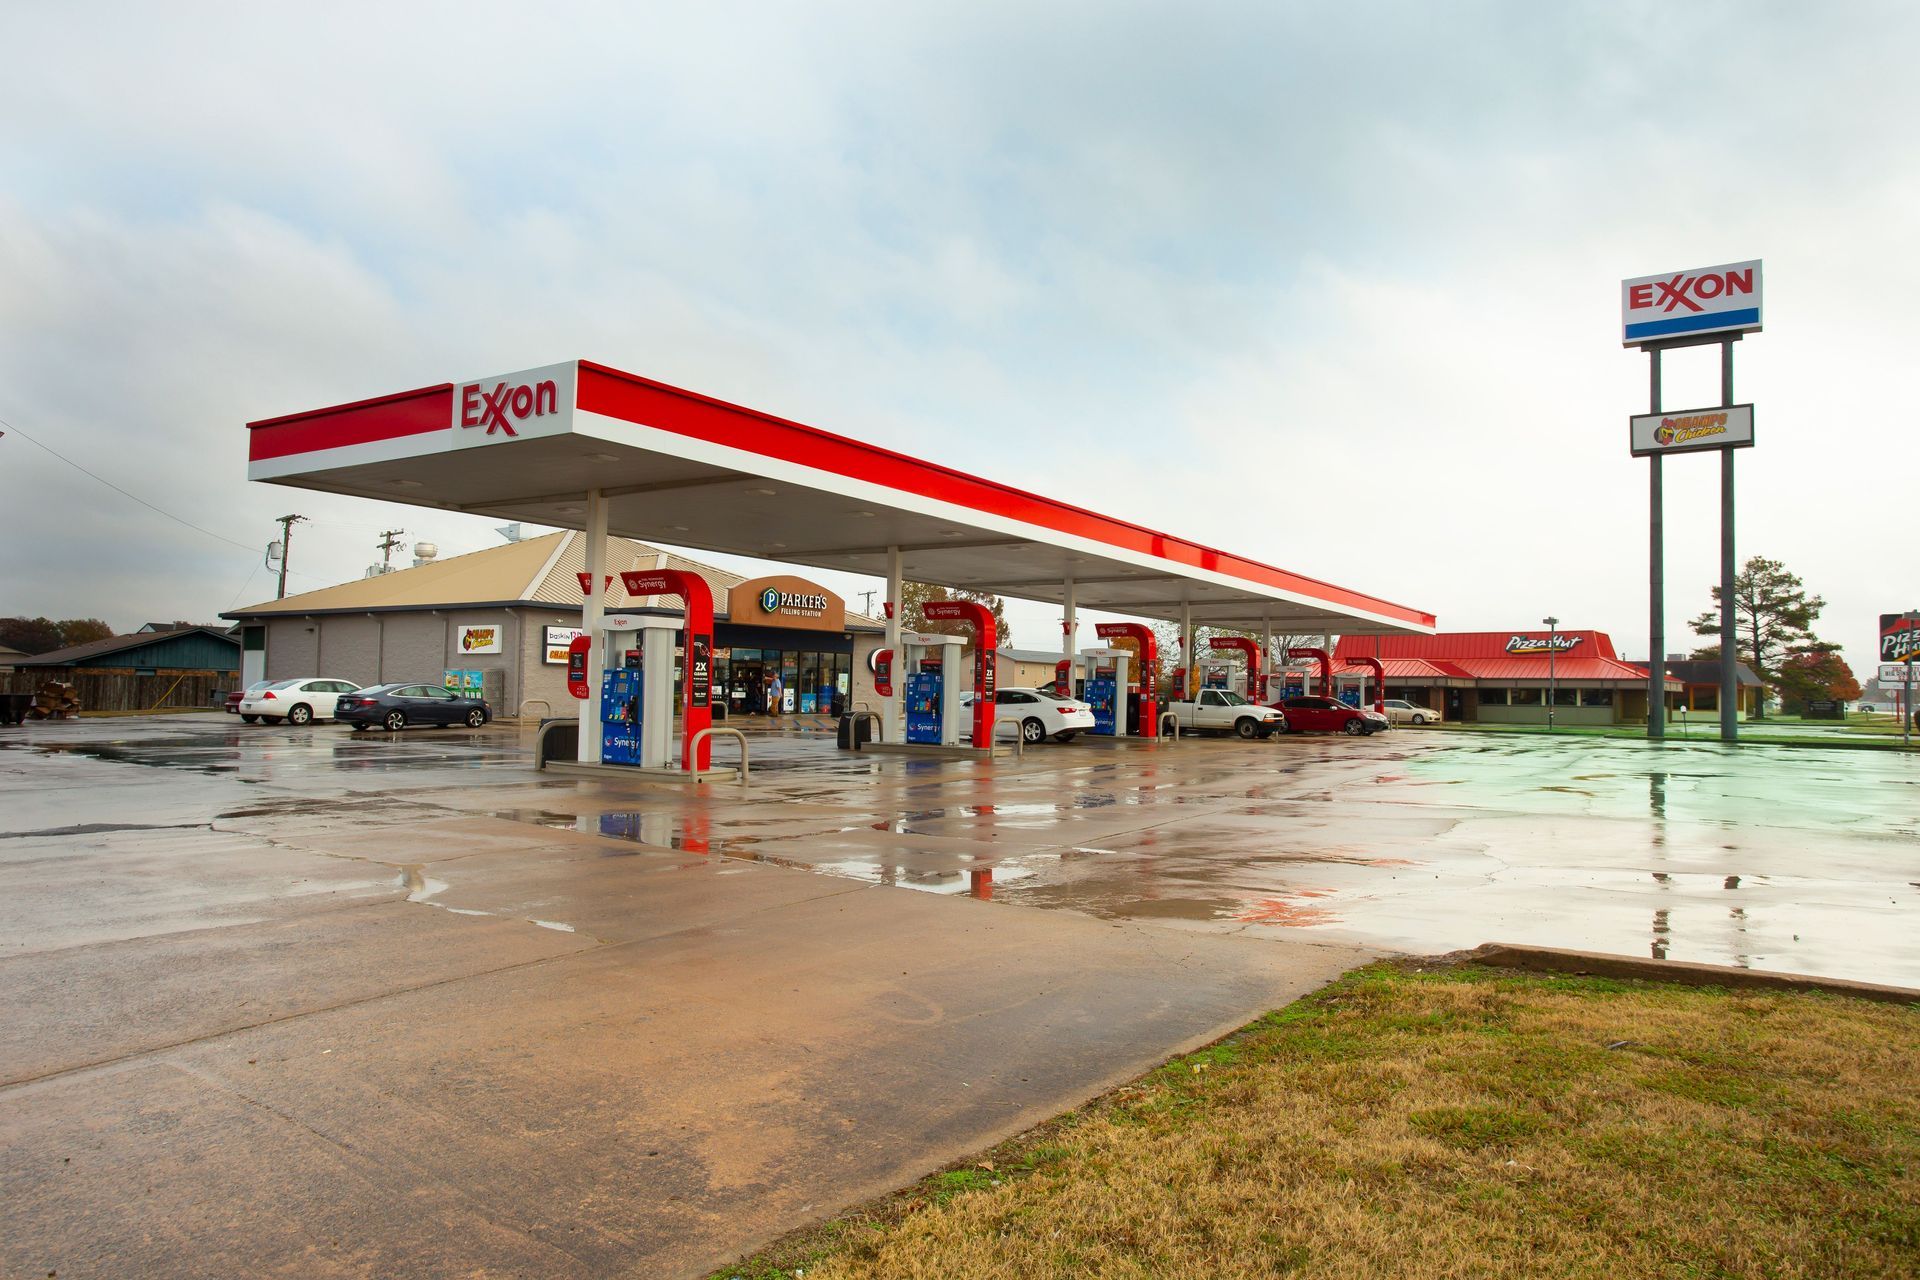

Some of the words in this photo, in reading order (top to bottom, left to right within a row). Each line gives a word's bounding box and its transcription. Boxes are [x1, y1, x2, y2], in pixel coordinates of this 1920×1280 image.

[1629, 268, 1753, 312] EXXON
[1674, 425, 1727, 443] Chicken
[638, 580, 667, 590] Synergy
[780, 592, 828, 610] PARKER'S
[780, 607, 801, 616] FILLING
[801, 609, 822, 618] STATION
[936, 608, 961, 616] Synergy
[1505, 635, 1547, 651] Pizza
[1548, 634, 1583, 648] Hut
[549, 650, 569, 660] CHAM
[695, 662, 707, 672] 2X
[917, 723, 941, 732] Synery
[614, 737, 640, 749] Synegy
